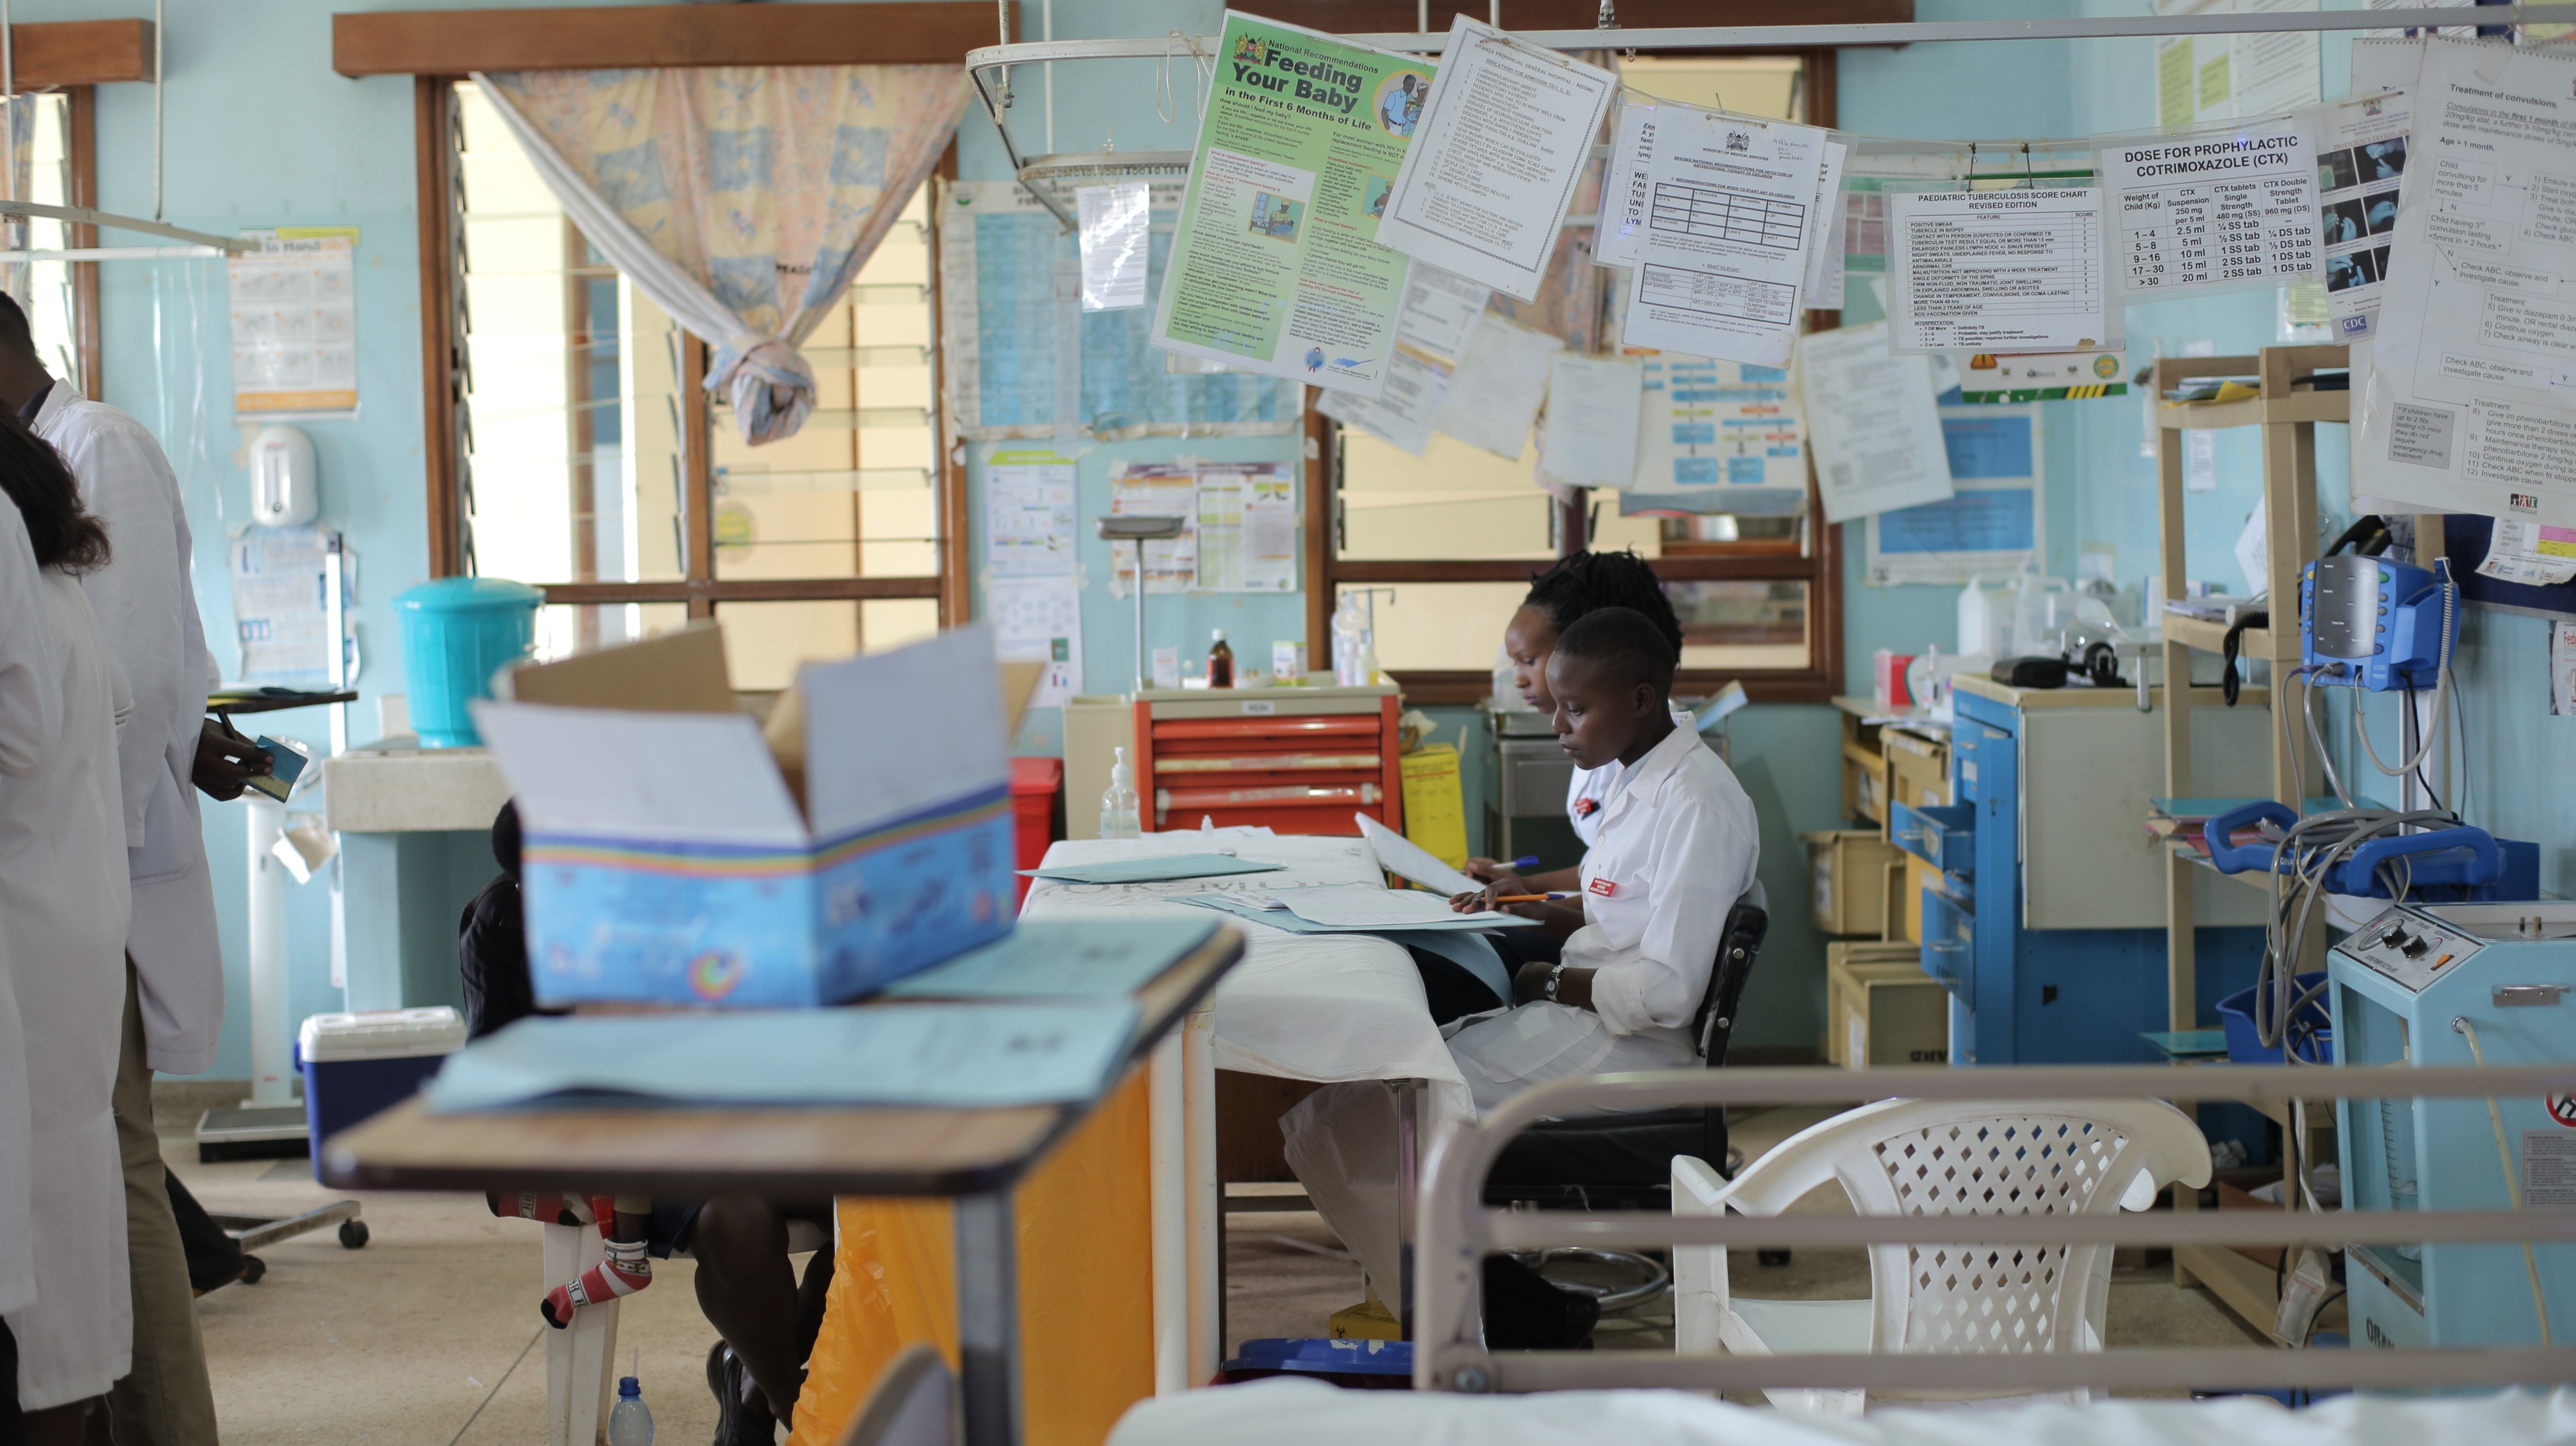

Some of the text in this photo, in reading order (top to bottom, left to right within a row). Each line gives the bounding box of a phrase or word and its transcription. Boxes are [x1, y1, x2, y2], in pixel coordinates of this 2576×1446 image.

[1268, 40, 1378, 73] National Recommendations
[1264, 49, 1363, 94] Feeding
[1232, 62, 1358, 114] Your Baby
[2451, 84, 2493, 98] Treatment
[1225, 87, 1235, 96] in
[1239, 90, 1256, 101] the
[1259, 95, 1284, 109] First
[1287, 103, 1293, 111] 6
[1296, 104, 1335, 121] Months
[1352, 119, 1371, 130] Life
[1232, 101, 1250, 109] should
[1275, 111, 1291, 120] baby?
[2447, 102, 2489, 115] Convulsions
[2498, 111, 2510, 119] the
[2511, 112, 2527, 121] first
[2534, 118, 2559, 126] month
[2439, 137, 2455, 145] Age
[2125, 136, 2298, 163] DOSE FOR PROPHYLACTIC
[2137, 152, 2288, 177] COTRIMOXAZOLE (CTX)
[2440, 161, 2458, 169] Child
[2438, 170, 2487, 183] convulsing for
[2230, 183, 2256, 192] tablets
[2263, 178, 2307, 188] CTX Double
[2456, 182, 2472, 190] than
[1967, 193, 2029, 201] TUBERCULOSIS
[2180, 188, 2195, 196] CTX
[2224, 193, 2247, 201] Single
[2270, 187, 2302, 197] Strength
[2435, 188, 2463, 198] minutes
[2124, 193, 2150, 202] Weight
[2167, 197, 2209, 207] Suspension
[2275, 197, 2299, 205] Tablet
[2124, 201, 2160, 211] Child (Kg)
[2221, 201, 2253, 210] Strength
[2294, 205, 2310, 214] (DS)
[2176, 207, 2190, 215] 250
[2245, 209, 2261, 219] (SS)
[2177, 225, 2205, 235] 2.5 ml
[2228, 221, 2241, 230] SS
[2243, 220, 2259, 229] tab
[2134, 230, 2156, 239] 1 4
[2230, 233, 2242, 242] SS
[2244, 232, 2260, 241] tab
[2136, 241, 2157, 251] 5 8
[2182, 237, 2201, 247] 5 ml
[2181, 248, 2206, 258] 10 ml
[2221, 243, 2260, 255] 1 SS tab
[2133, 253, 2160, 263] 9 16
[2133, 265, 2164, 275] 17 30
[2461, 262, 2483, 272] Check
[2504, 270, 2533, 280] observe
[2148, 277, 2158, 286] 30
[2459, 271, 2496, 283] investigate
[2344, 317, 2365, 329] CDC
